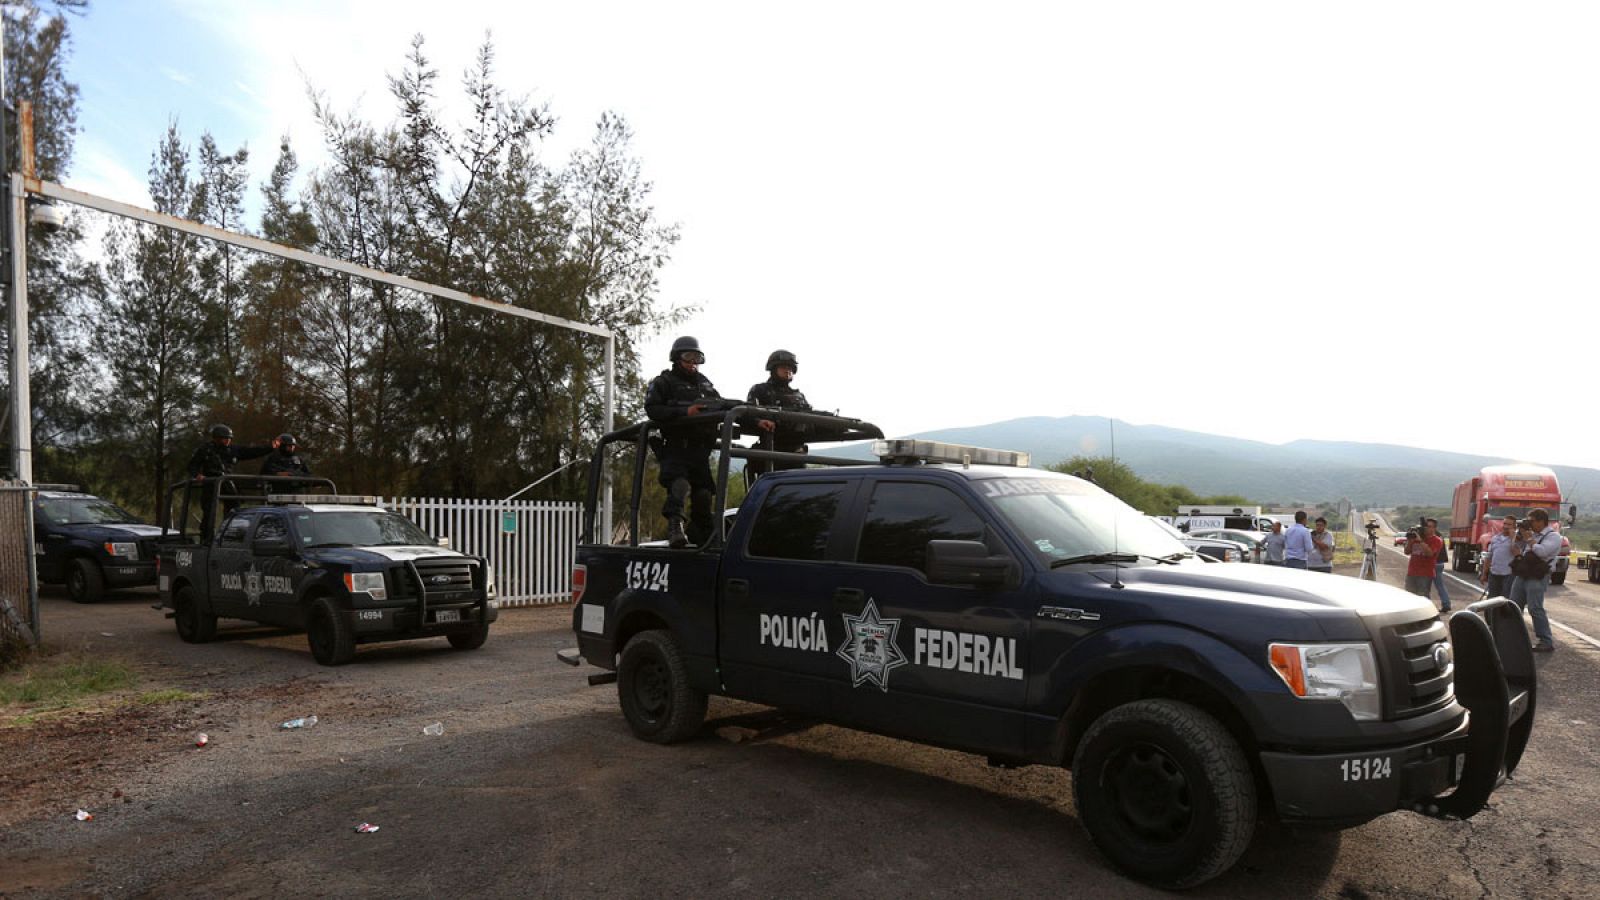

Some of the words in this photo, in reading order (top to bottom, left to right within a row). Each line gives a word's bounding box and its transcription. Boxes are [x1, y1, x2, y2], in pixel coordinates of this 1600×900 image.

[264, 575, 294, 594] FEDERAL
[625, 560, 670, 592] 15124
[360, 610, 383, 620] 14994
[760, 611, 828, 652] POLICÍA
[914, 627, 1023, 680] FEDERAL
[1341, 757, 1392, 781] 15124
